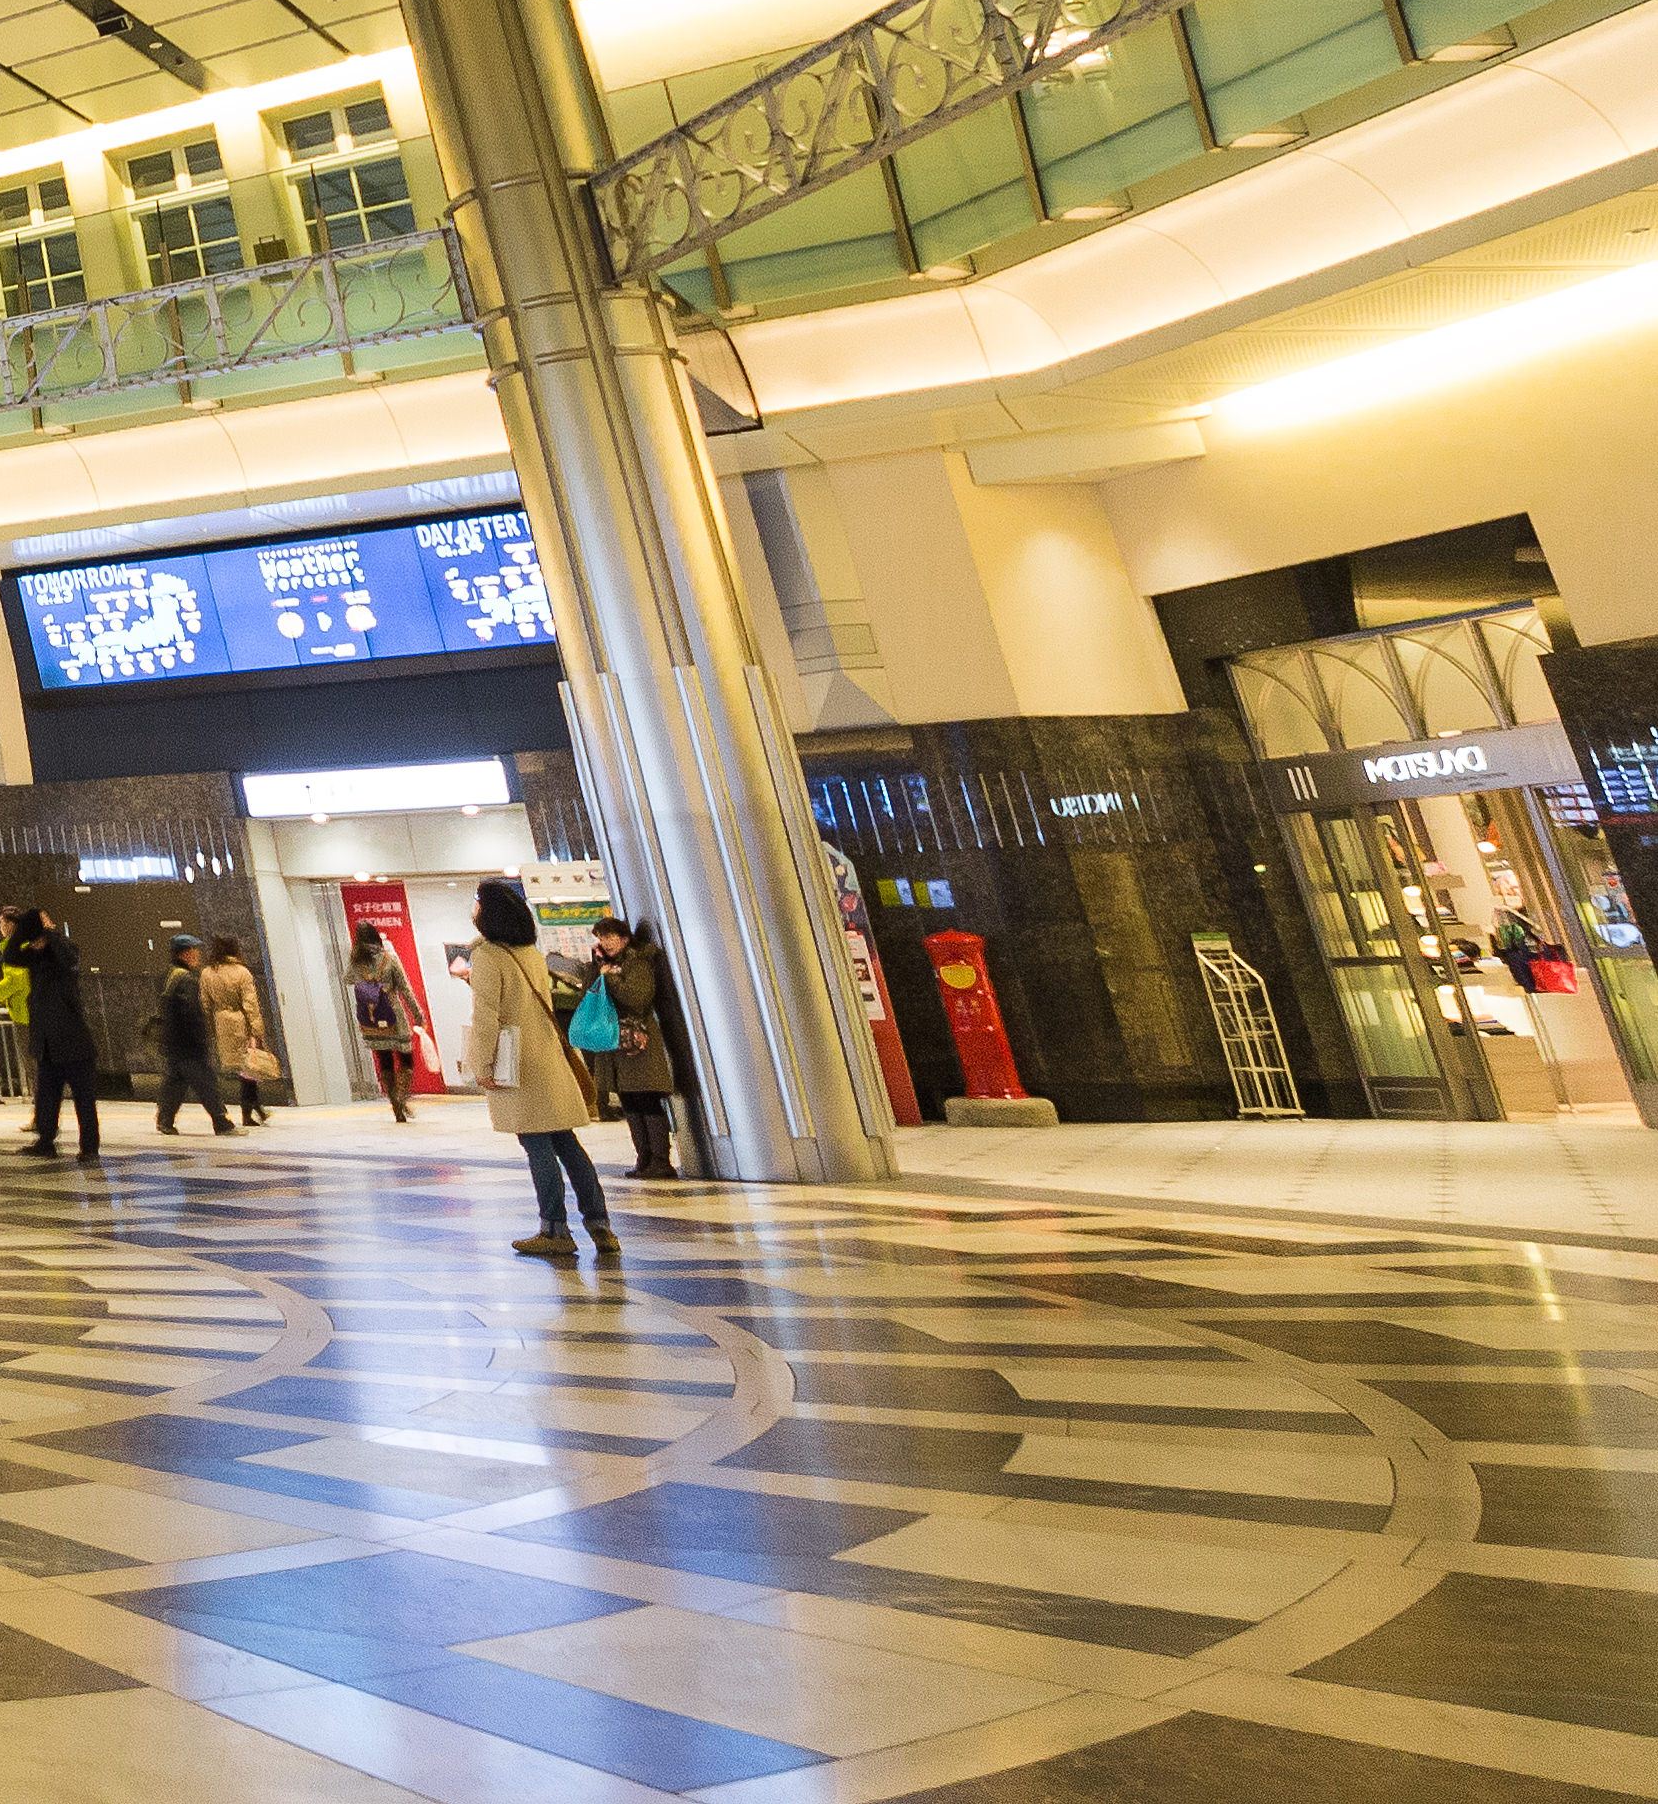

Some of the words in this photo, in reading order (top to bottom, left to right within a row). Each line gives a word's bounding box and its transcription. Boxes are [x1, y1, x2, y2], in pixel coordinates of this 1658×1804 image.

[416, 522, 453, 548] DAY
[458, 513, 520, 542] AFTER
[21, 563, 128, 596] TOMORROW
[258, 551, 360, 579] Weather
[264, 567, 365, 592] forecast
